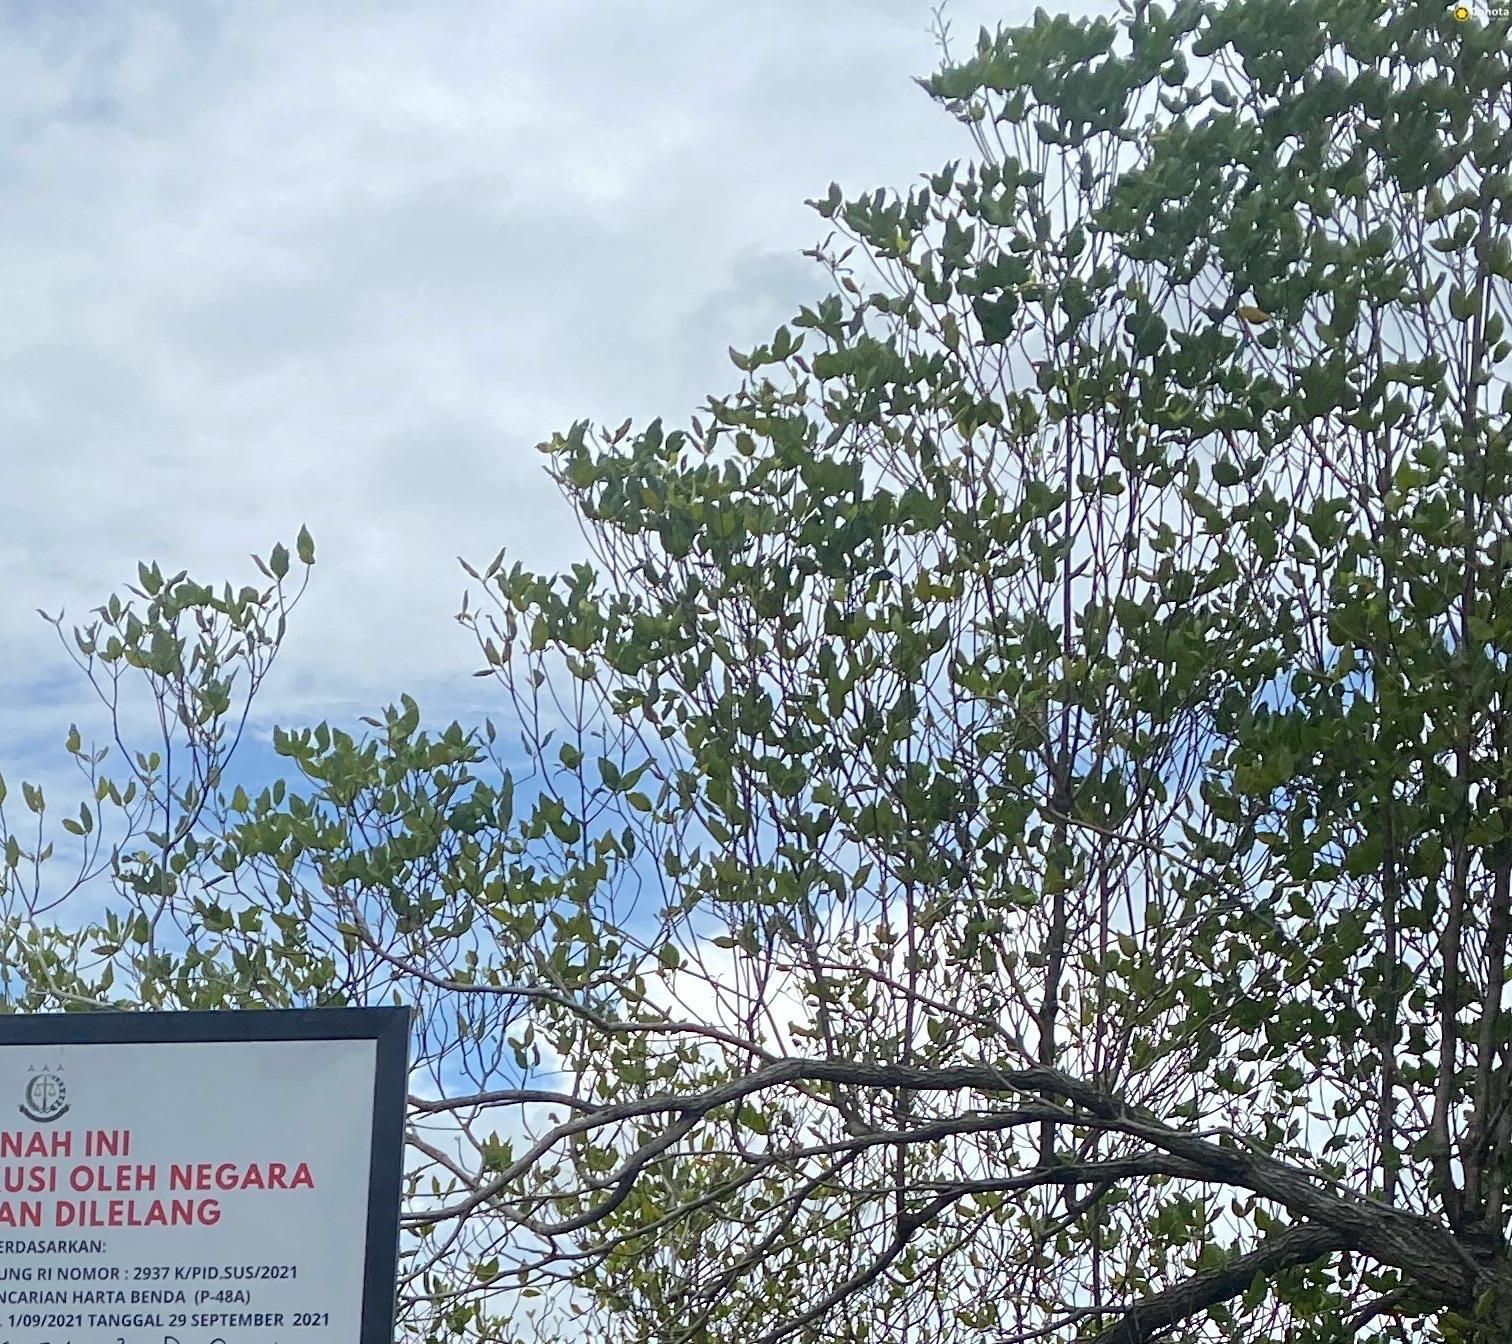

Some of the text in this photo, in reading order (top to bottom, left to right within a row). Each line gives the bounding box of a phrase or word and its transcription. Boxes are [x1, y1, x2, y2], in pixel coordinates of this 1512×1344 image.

[85, 1130, 130, 1157] INI
[70, 1165, 156, 1192] OLEH
[169, 1163, 315, 1191] NEGARA
[55, 1198, 221, 1227] DILELANG
[37, 1267, 52, 1281] RI
[57, 1266, 120, 1281] NOMOR
[133, 1266, 170, 1280] 2937
[175, 1264, 297, 1280] K/PID.SUS/2021
[72, 1290, 126, 1304] HARTA
[131, 1290, 186, 1304] BENDA
[194, 1289, 251, 1306] (P-48A)
[8, 1313, 83, 1329] 1/09/2021
[88, 1313, 164, 1327] TANGGAL
[168, 1313, 187, 1327] 29
[191, 1313, 284, 1327] SEPTEMBER
[292, 1312, 329, 1327] 2021
